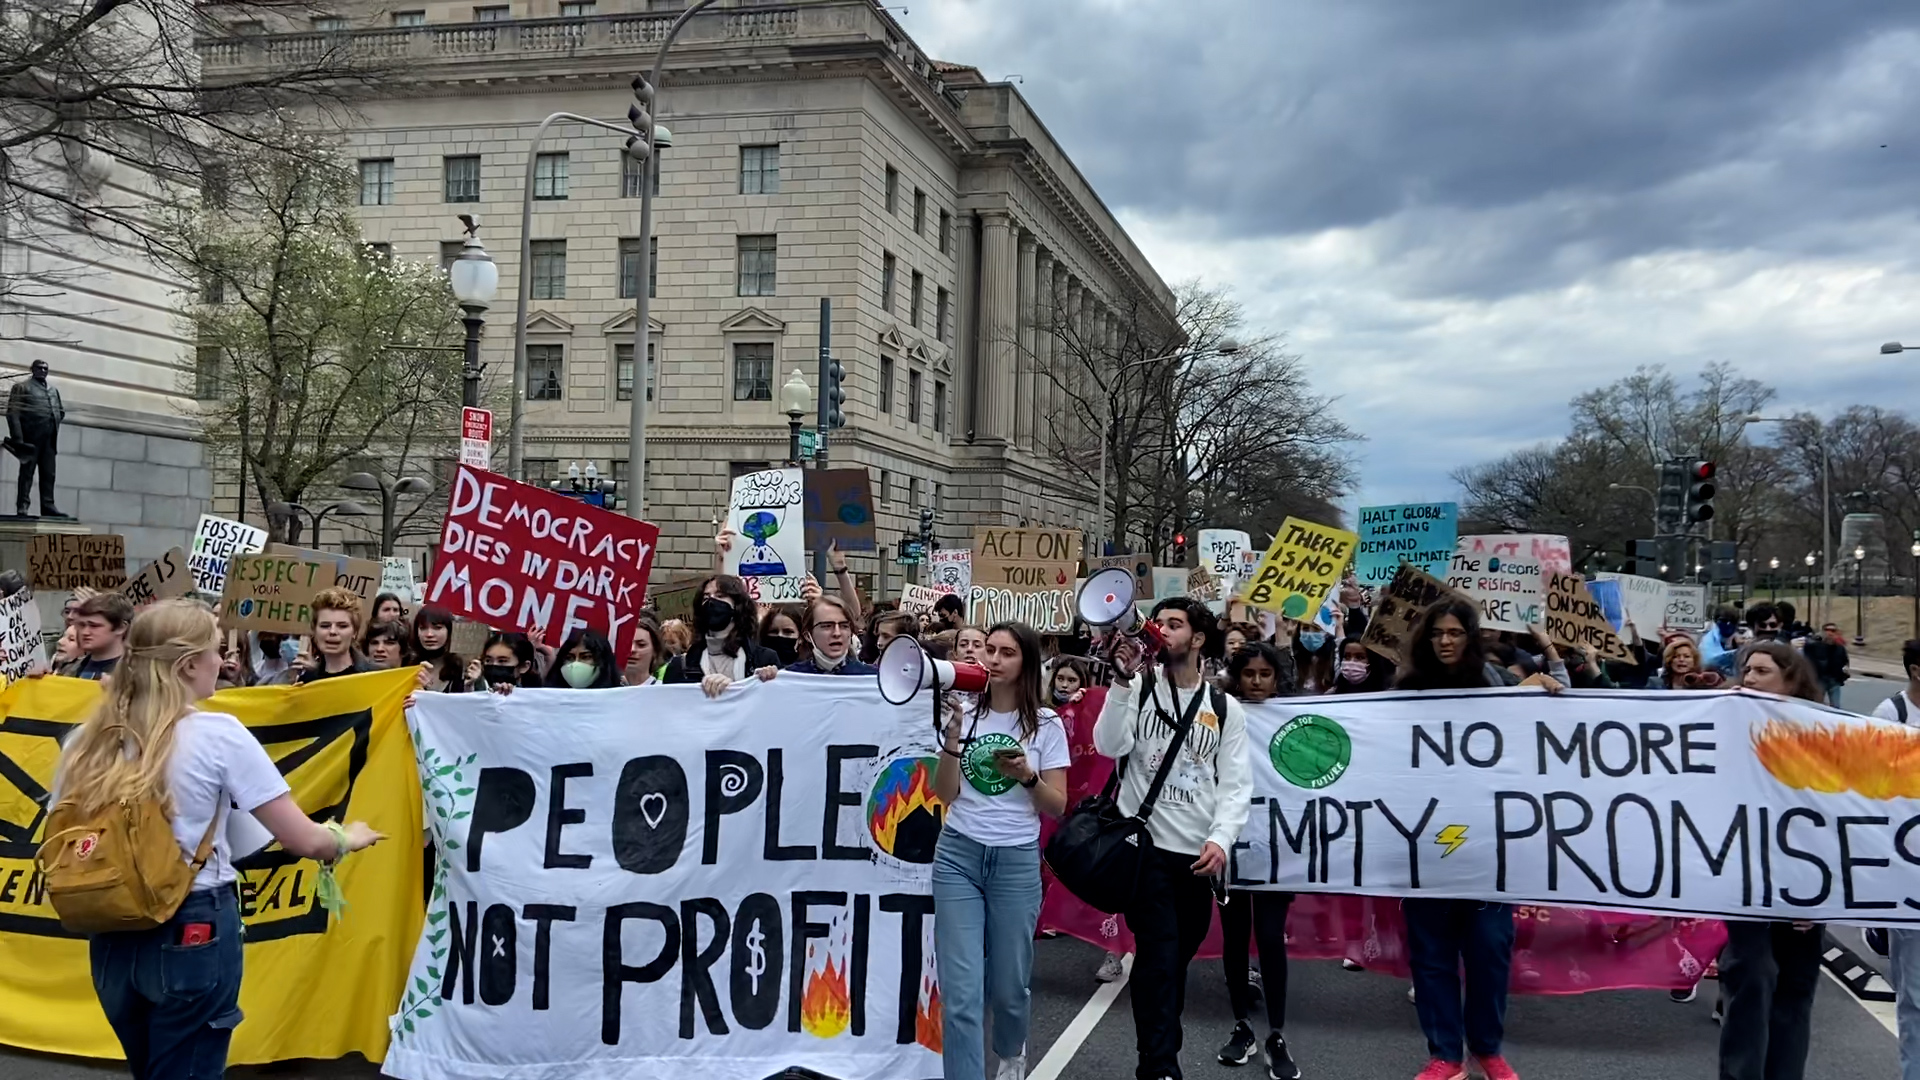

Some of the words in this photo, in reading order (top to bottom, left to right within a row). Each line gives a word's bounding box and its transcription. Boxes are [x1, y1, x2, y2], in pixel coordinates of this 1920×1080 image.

[469, 411, 485, 422] SNOW
[745, 471, 783, 488] TWO
[450, 466, 651, 570] DEMOCRACY
[1362, 509, 1397, 525] HALT
[1402, 506, 1446, 520] GLOBAL
[201, 519, 260, 549] FOSSIL
[1371, 521, 1430, 536] HEATING
[32, 535, 70, 553] THE
[981, 530, 1027, 558] ACT
[1036, 532, 1071, 560] ON
[1283, 524, 1349, 560] THERE
[1360, 538, 1417, 553] DEMAND
[29, 554, 65, 574] SAY
[153, 551, 177, 584] IS
[188, 554, 209, 571] ARE
[443, 520, 511, 566] DIES
[520, 550, 552, 581] IN
[554, 560, 638, 609] DARK
[1214, 563, 1238, 573] OUR
[1216, 554, 1235, 564] ECT
[1271, 546, 1296, 567] IS
[1295, 555, 1334, 577] NO
[1396, 550, 1451, 563] CLIMATE
[1451, 554, 1481, 572] The
[1488, 557, 1540, 576] Oceans
[33, 573, 91, 589] ACTION
[94, 573, 128, 589] NOW
[231, 557, 320, 587] RESPECT
[1002, 566, 1047, 587] YOUR
[1256, 565, 1331, 599] PLANET
[1447, 576, 1472, 589] are
[1549, 572, 1580, 595] ACT
[252, 584, 281, 596] YOUR
[1249, 583, 1272, 604] B
[226, 597, 312, 623] MOTHER
[429, 560, 635, 653] MONEY
[1480, 599, 1511, 623] ARE
[1515, 603, 1539, 625] WE
[1547, 591, 1569, 613] ON
[1570, 598, 1606, 622] YOUR
[9, 610, 22, 629] ON
[1546, 615, 1628, 658] PROMISES
[980, 734, 1001, 745] FOR
[1411, 721, 1504, 769] NO
[1535, 720, 1717, 779] MORE
[1311, 761, 1345, 788] FUTURE
[465, 744, 880, 874] PEOPLE
[1230, 796, 1439, 889] EMPTY
[441, 901, 577, 1011] NOT
[601, 890, 937, 1046] PROFIT
